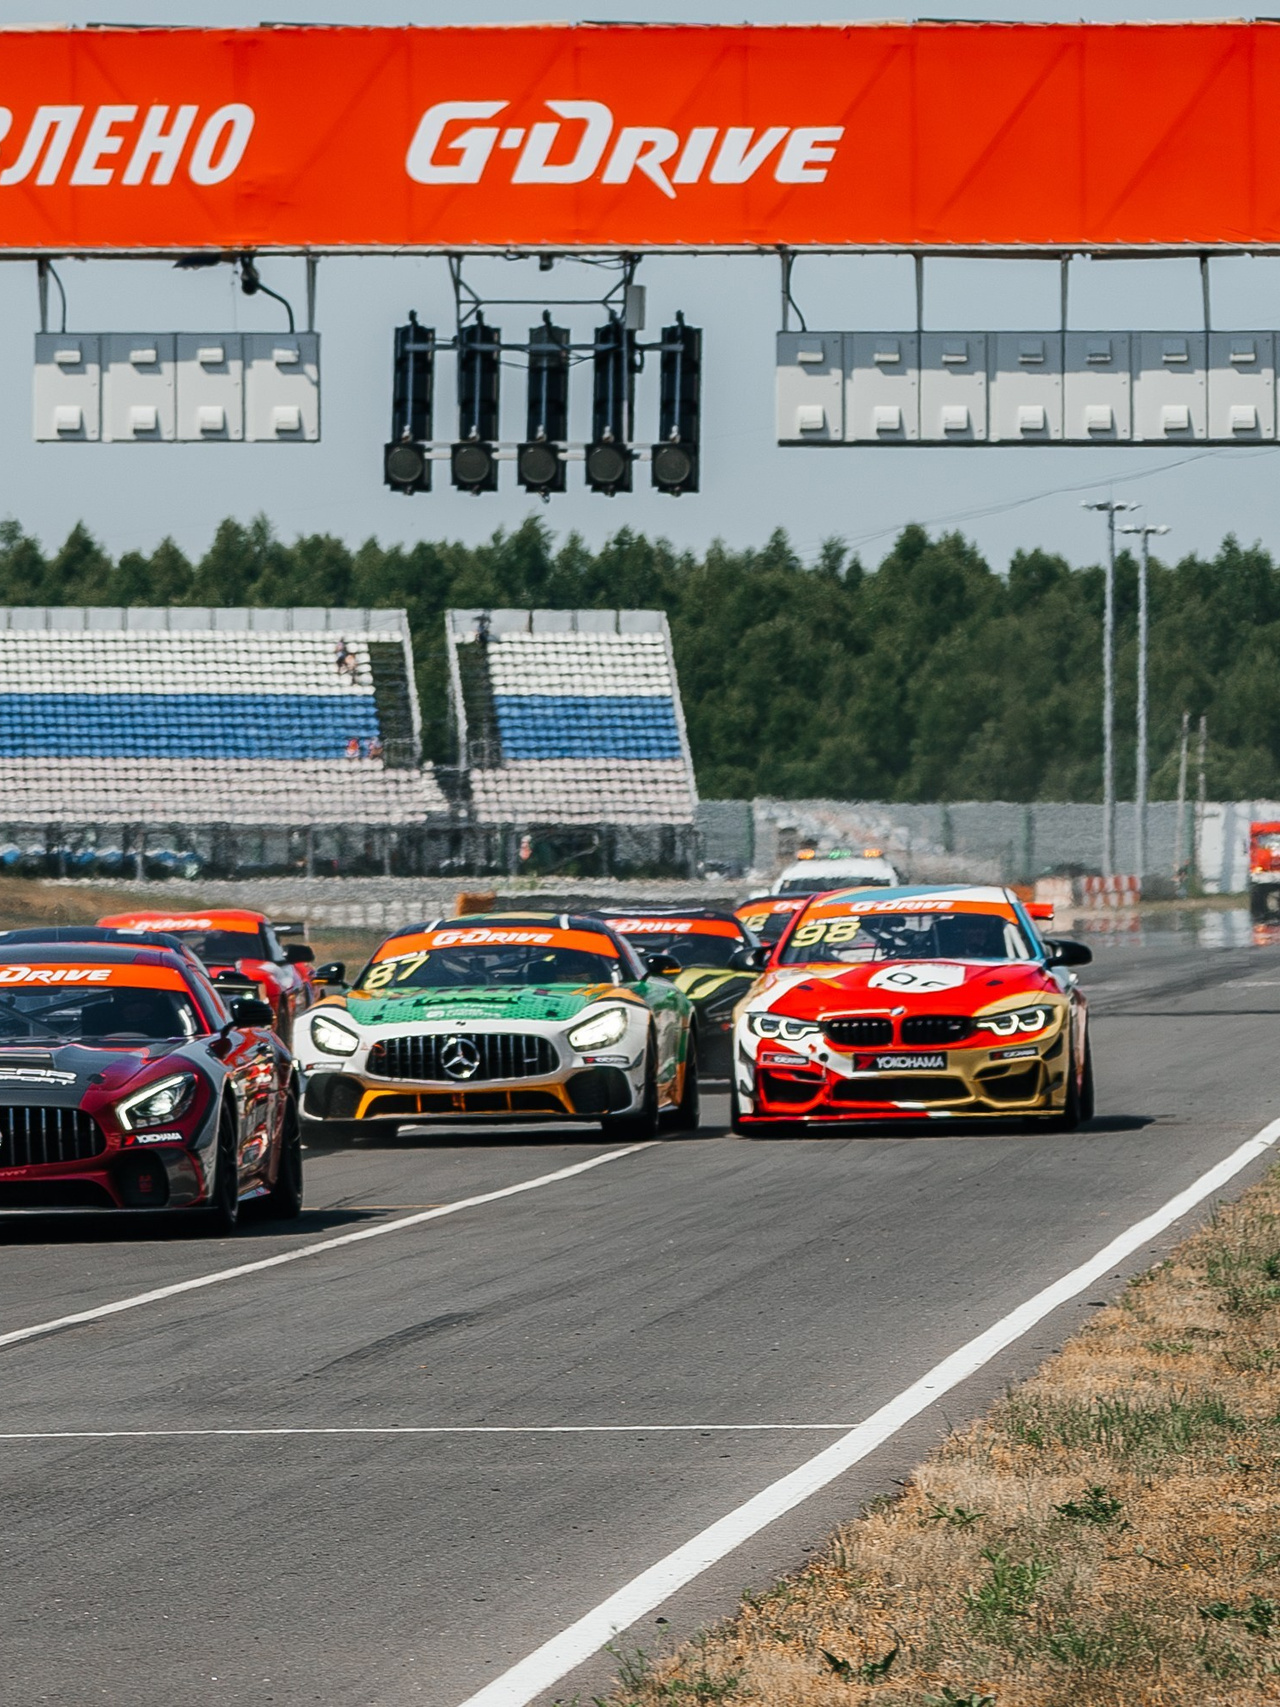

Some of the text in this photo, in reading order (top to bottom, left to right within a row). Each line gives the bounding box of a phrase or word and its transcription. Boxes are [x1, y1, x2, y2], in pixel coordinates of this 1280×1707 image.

[791, 921, 862, 948] 98
[363, 955, 430, 990] 87
[875, 1056, 944, 1069] YOKOHAMA
